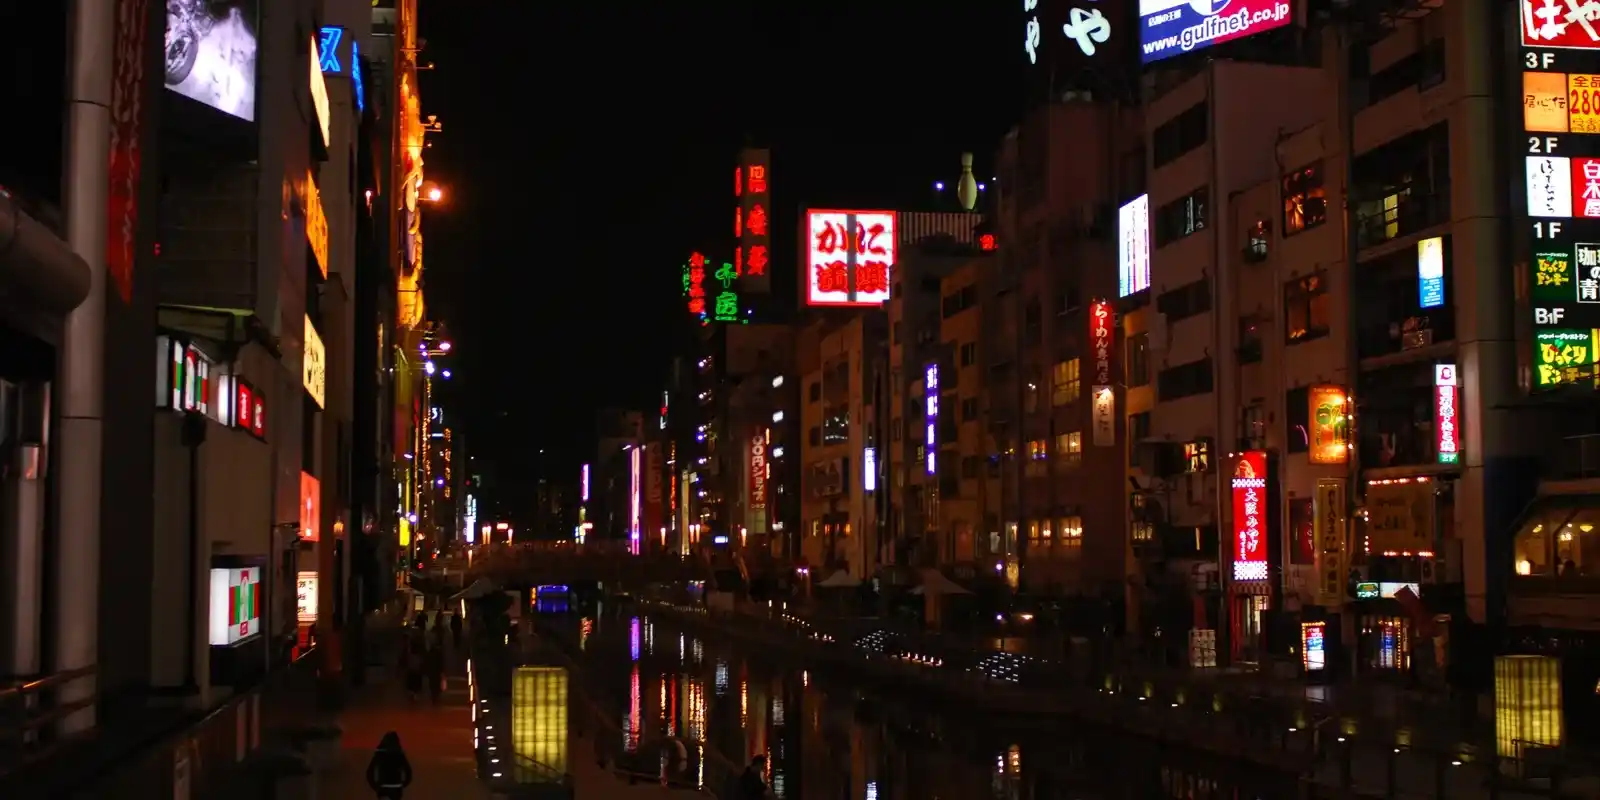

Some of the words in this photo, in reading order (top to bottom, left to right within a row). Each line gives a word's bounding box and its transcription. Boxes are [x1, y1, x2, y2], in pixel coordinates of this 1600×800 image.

[1143, 2, 1290, 54] www.gulfnet.co.jp
[1525, 52, 1555, 69] 3F
[1528, 136, 1558, 153] 2F
[1582, 160, 1600, 216] 白木屋
[815, 220, 887, 255] かに
[1533, 221, 1561, 239] 1F
[1537, 258, 1568, 273] びっくり
[1577, 247, 1600, 266] 珈
[1536, 272, 1569, 286] ドンキー
[1534, 307, 1565, 324] B1F
[1540, 343, 1587, 365] びっくり
[1244, 487, 1259, 553] 大阪みやげ
